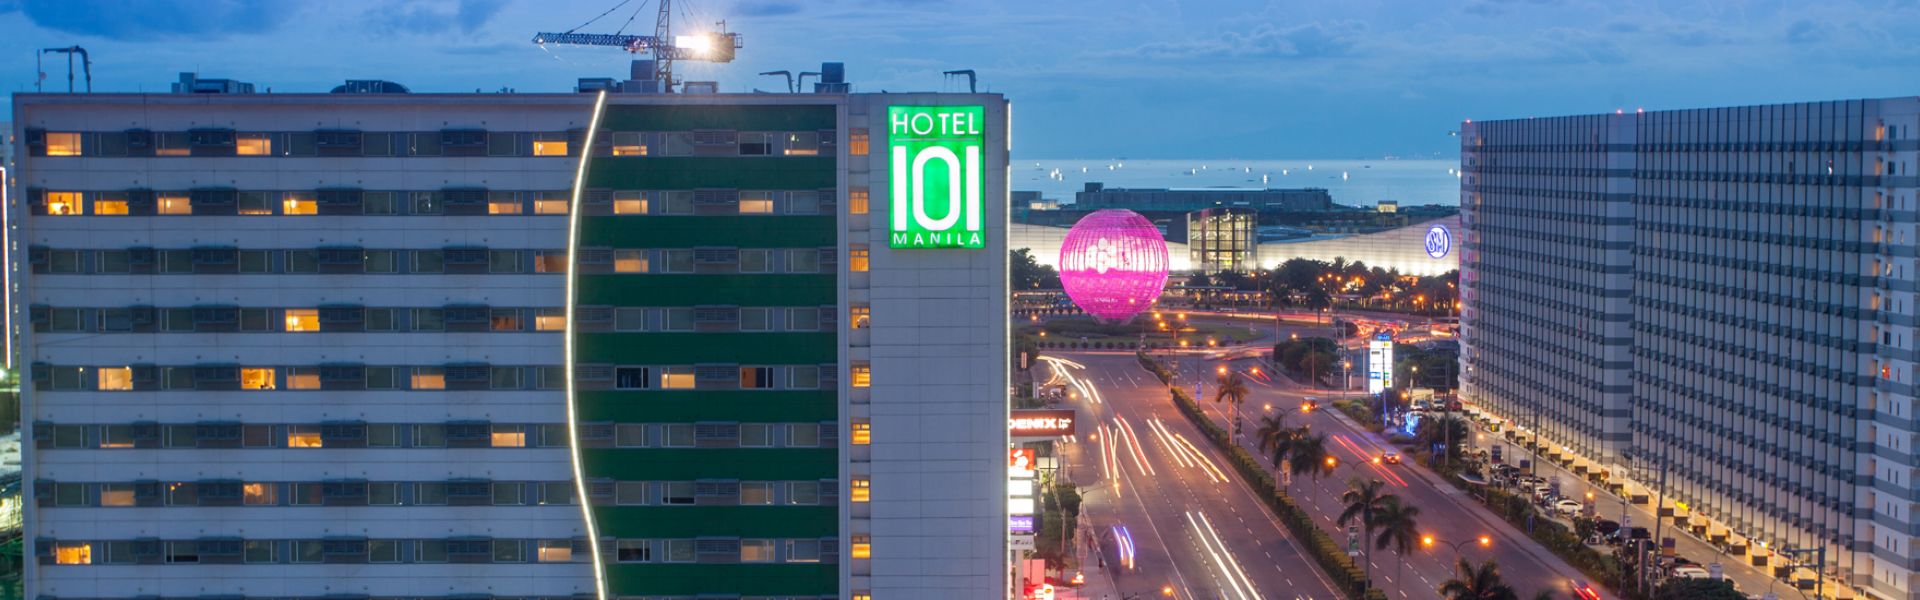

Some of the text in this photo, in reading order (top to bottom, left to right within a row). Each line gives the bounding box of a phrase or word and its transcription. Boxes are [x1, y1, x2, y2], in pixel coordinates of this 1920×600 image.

[892, 112, 979, 135] HOTEL
[893, 145, 980, 231] 101
[893, 233, 981, 245] MANILA
